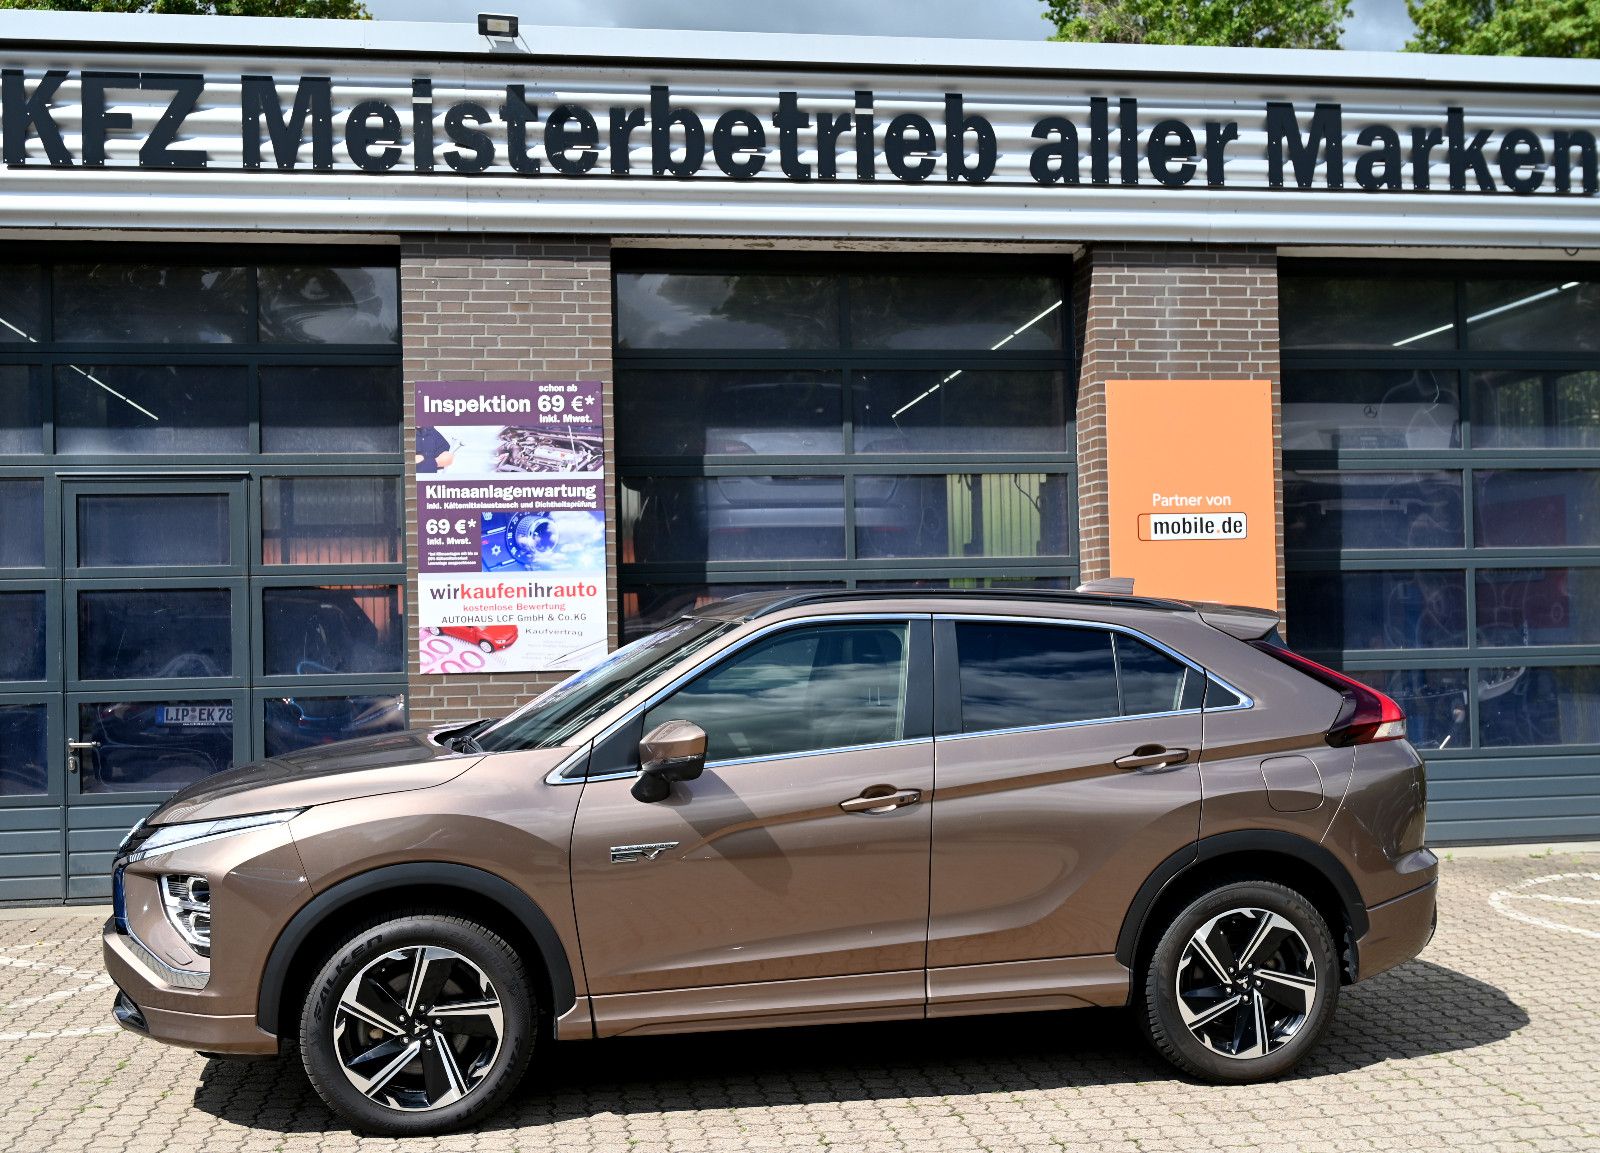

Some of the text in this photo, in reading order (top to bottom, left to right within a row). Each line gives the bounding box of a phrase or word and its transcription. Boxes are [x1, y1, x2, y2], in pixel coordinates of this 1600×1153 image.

[2, 69, 1600, 195] KFZ Meisterbetrieb aller Marken
[538, 384, 578, 392] schon ab
[423, 394, 531, 416] Inspektion
[537, 395, 565, 412] 69
[425, 484, 597, 501] Klimaanlagenwartung
[1151, 493, 1232, 507] Partner von
[426, 519, 451, 535] 69
[1153, 516, 1243, 535] mobile.de
[430, 582, 597, 600] wirkaufenihrauto
[463, 602, 566, 612] kostenlose Bewertung
[441, 615, 494, 624] AUTOHAUS
[497, 615, 514, 623] LCF
[517, 614, 544, 622] GmbH
[525, 628, 583, 636] Kaufvertrag
[165, 708, 190, 722] LIP
[198, 708, 214, 721] EK
